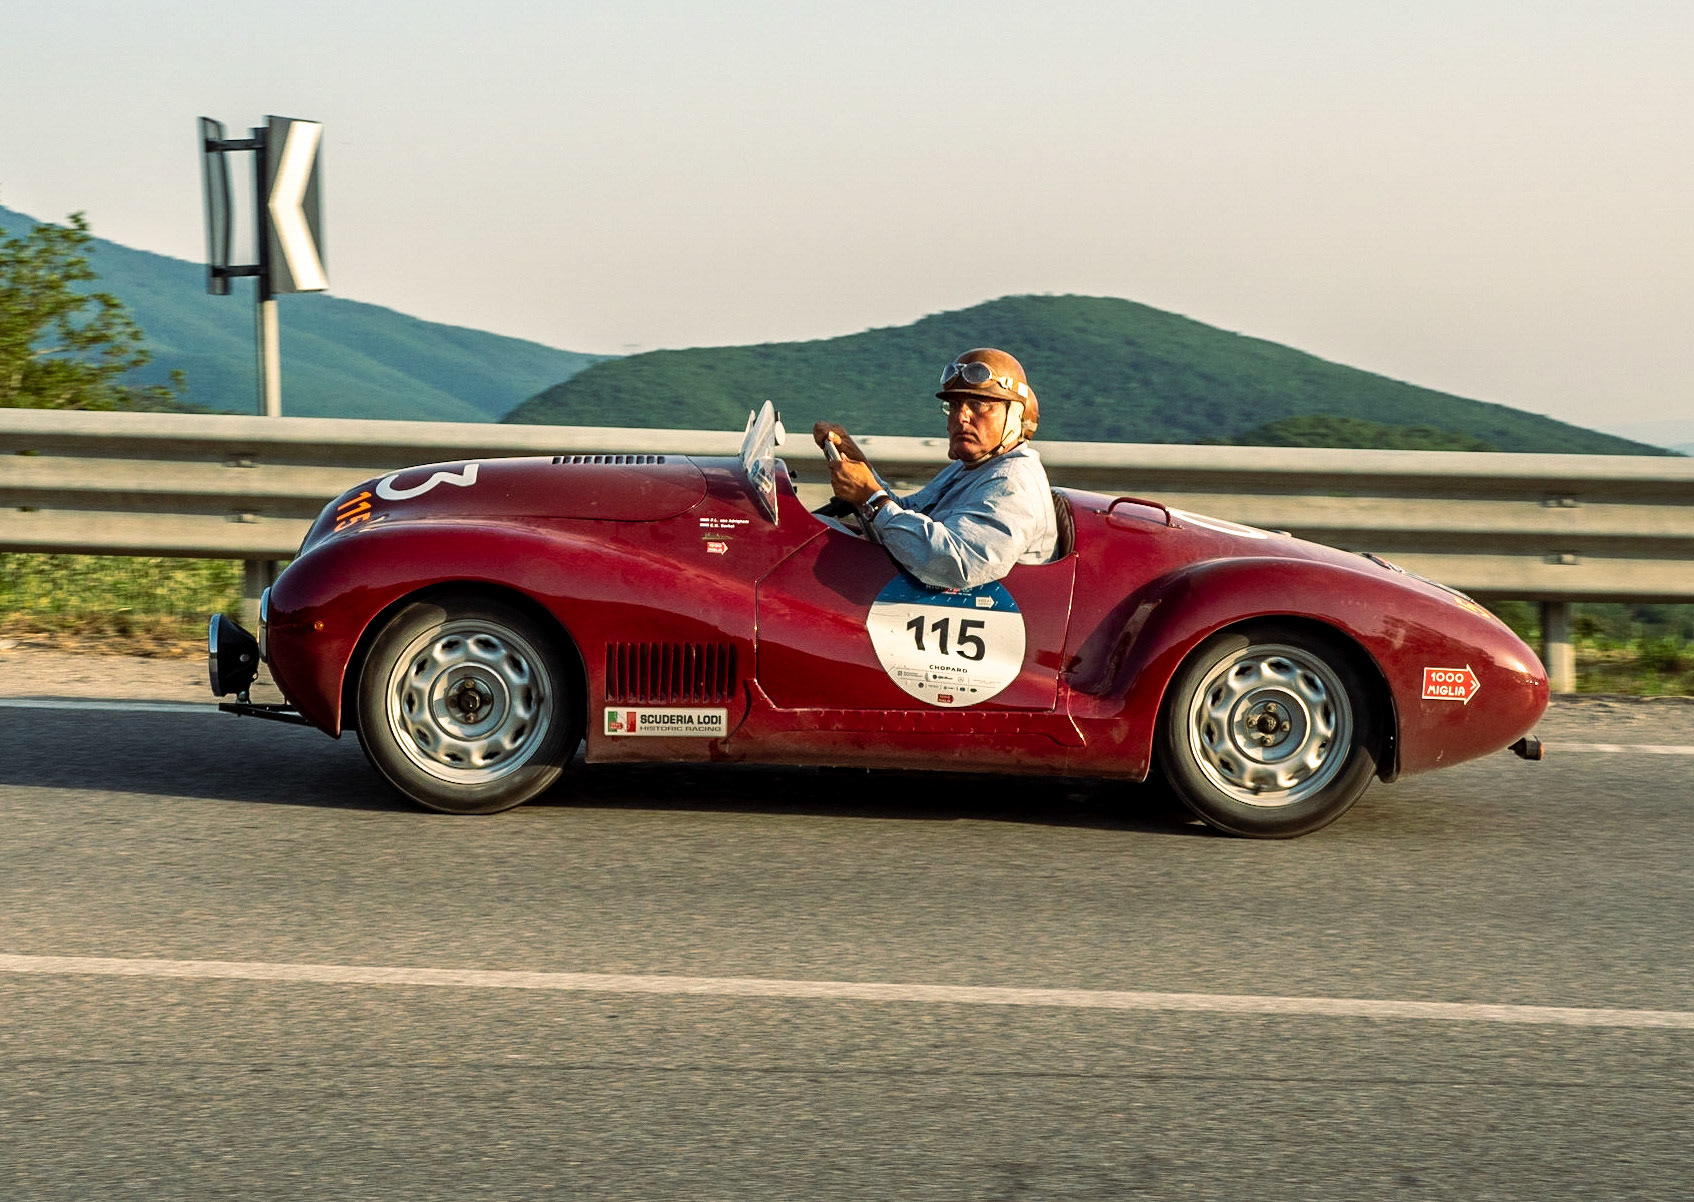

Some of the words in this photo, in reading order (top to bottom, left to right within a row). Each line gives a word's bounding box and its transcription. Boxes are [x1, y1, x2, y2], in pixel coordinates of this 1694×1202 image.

[376, 463, 480, 501] 3
[333, 491, 372, 532] 115
[906, 615, 986, 662] 115
[929, 664, 968, 674] CHOPARD
[1430, 671, 1465, 684] 1000
[1426, 684, 1466, 697] MIGLIA
[640, 714, 695, 725] SCUDERIA
[697, 715, 722, 726] LODI
